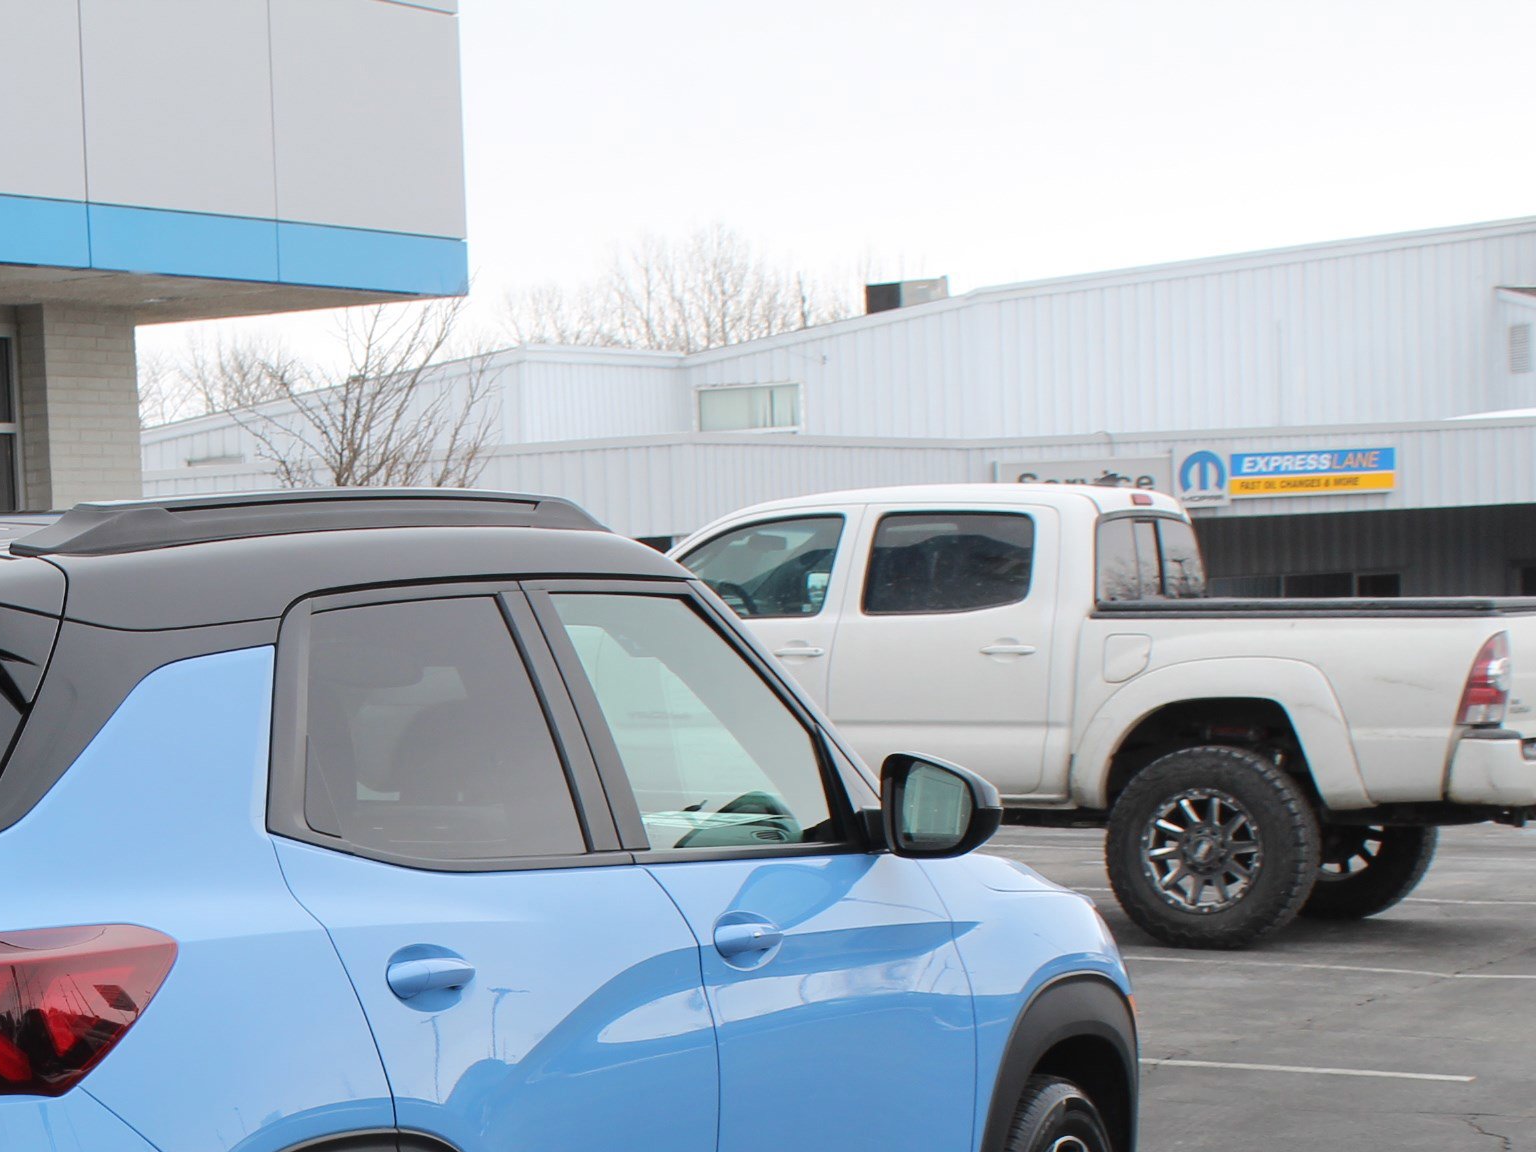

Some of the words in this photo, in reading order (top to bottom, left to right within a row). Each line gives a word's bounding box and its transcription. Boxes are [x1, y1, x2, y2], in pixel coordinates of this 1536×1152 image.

[1240, 481, 1261, 490] FAST
[1265, 480, 1276, 489] OIL
[1280, 479, 1321, 489] CHANGES
[1334, 477, 1359, 486] MORE
